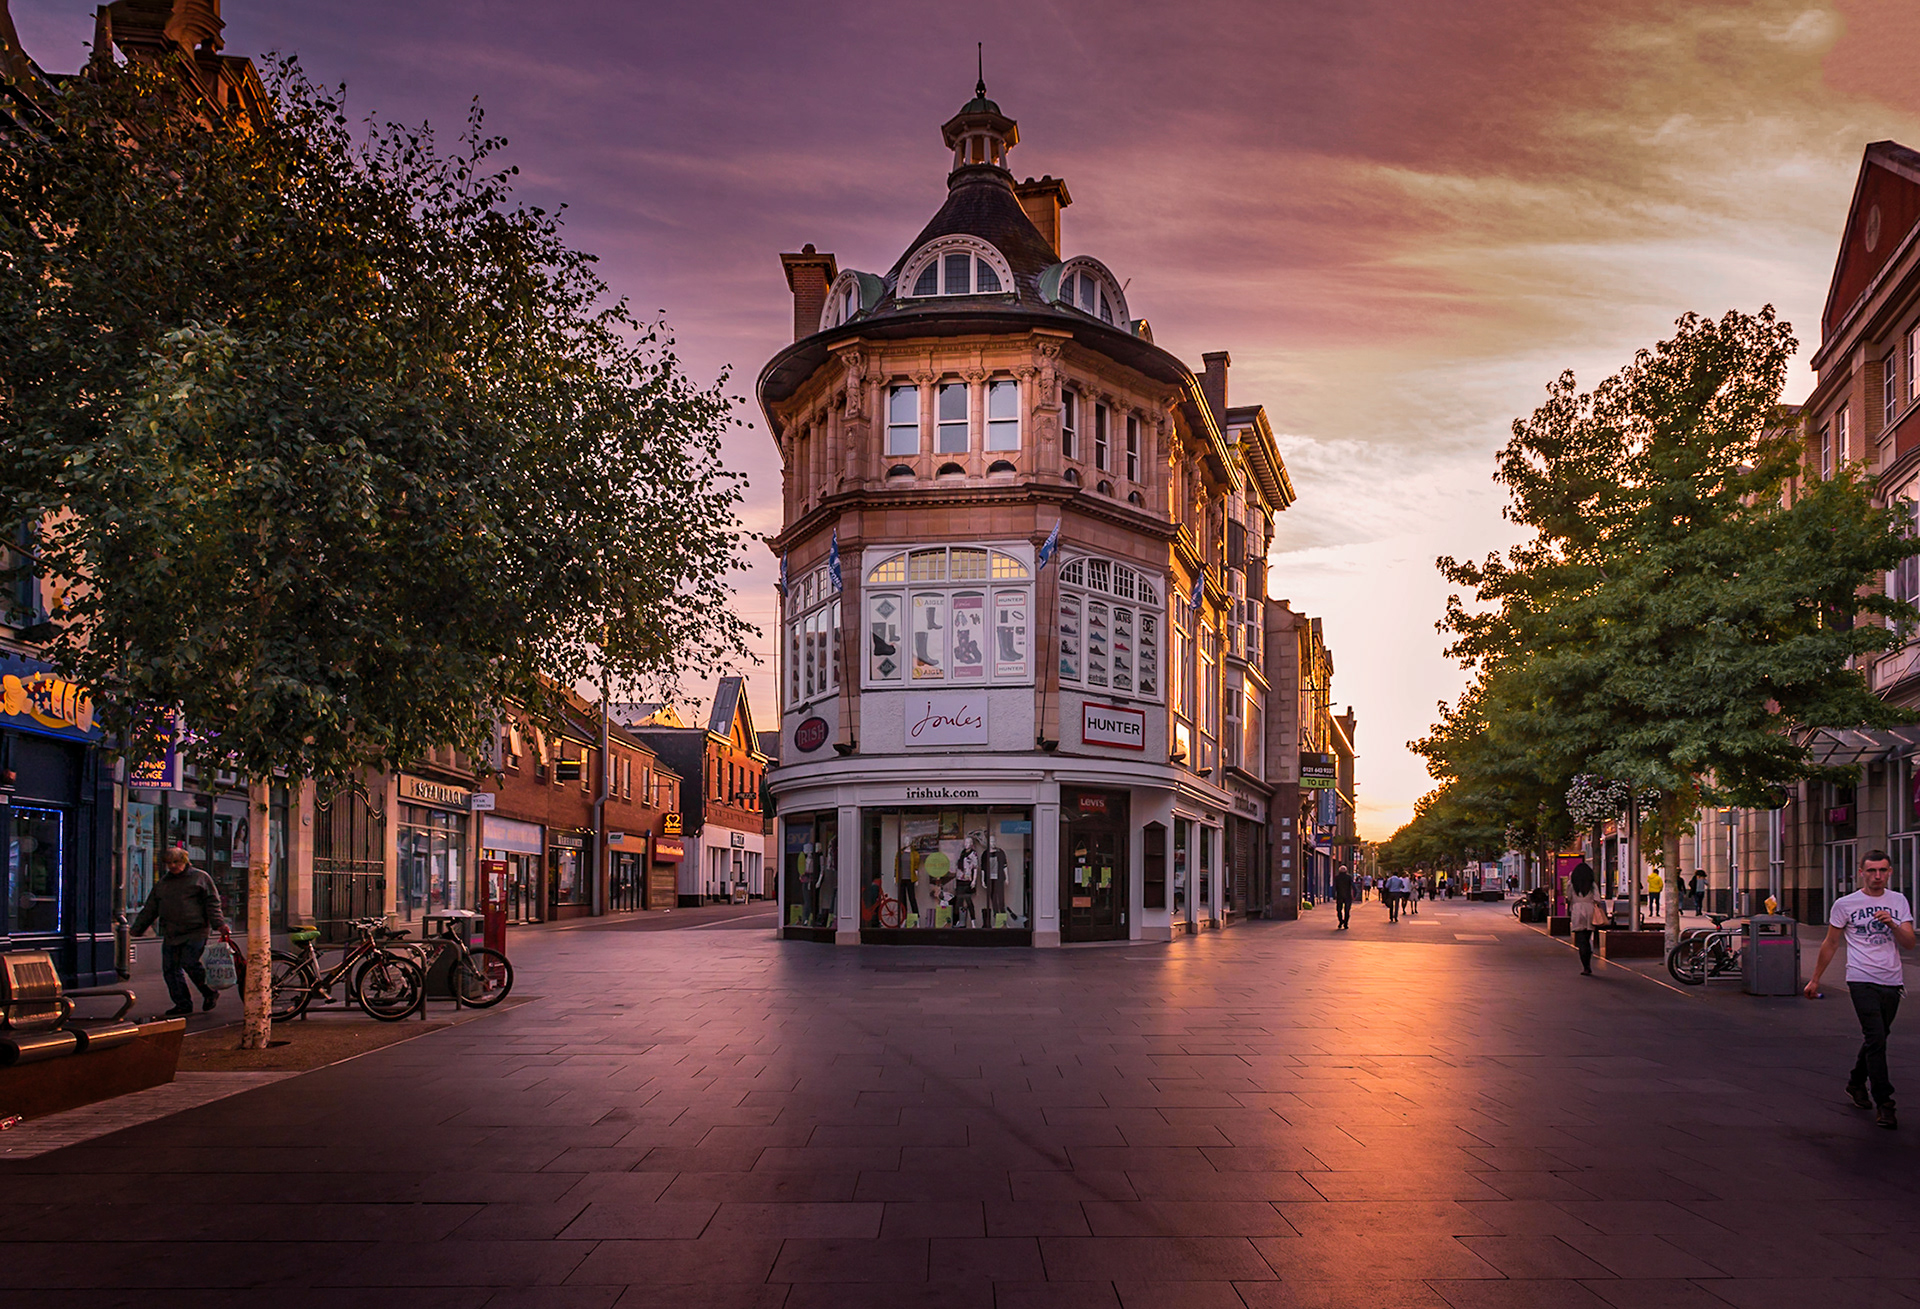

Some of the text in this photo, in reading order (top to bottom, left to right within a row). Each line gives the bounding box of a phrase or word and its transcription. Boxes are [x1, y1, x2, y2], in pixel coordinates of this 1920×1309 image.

[1113, 610, 1132, 624] VANS
[798, 722, 825, 745] IRISH
[1087, 716, 1140, 736] HUNTER
[906, 787, 979, 798] irishuk.com
